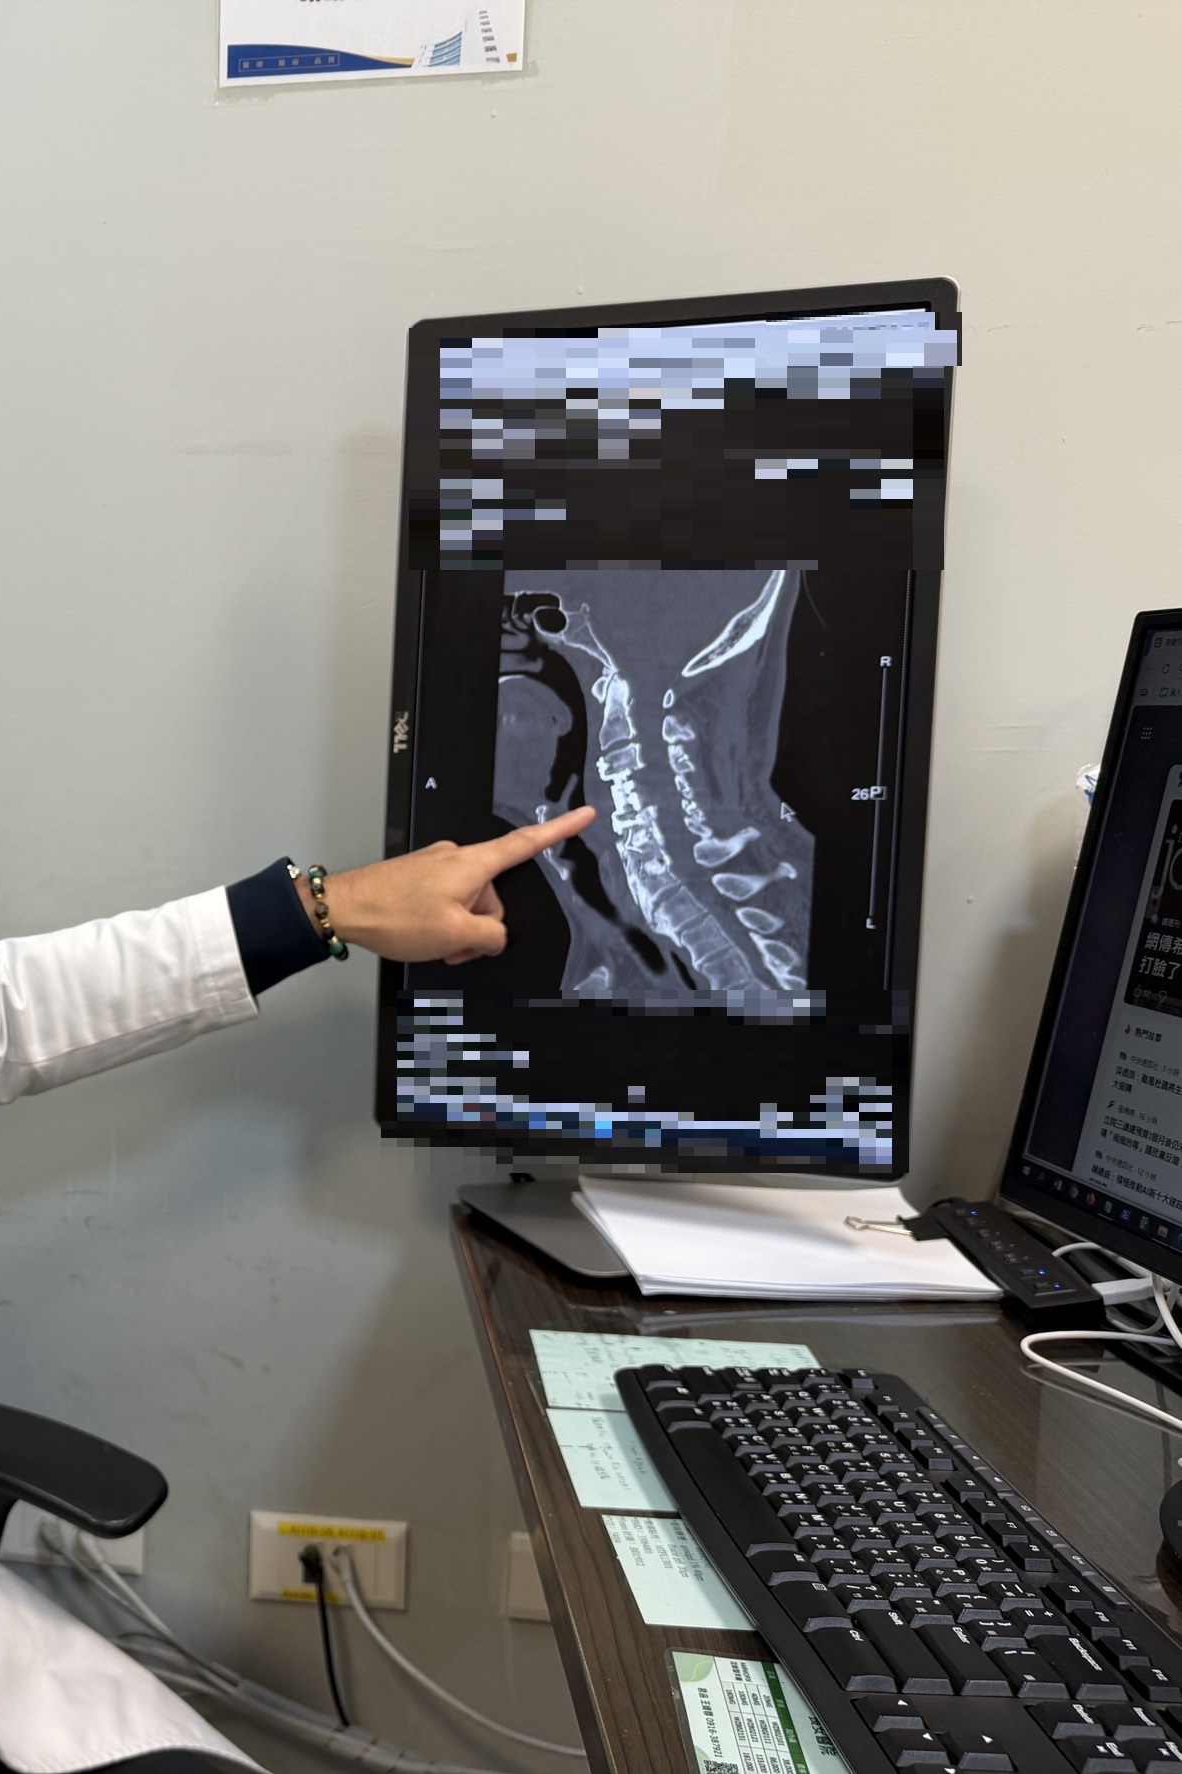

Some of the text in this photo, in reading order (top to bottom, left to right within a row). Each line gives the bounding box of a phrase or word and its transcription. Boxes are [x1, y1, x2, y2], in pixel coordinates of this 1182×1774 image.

[880, 656, 892, 666] R
[393, 711, 409, 754] DELL
[425, 777, 437, 789] A
[866, 917, 876, 929] L
[1139, 956, 1181, 979] 打臉了
[888, 1612, 904, 1625] Shift
[850, 1630, 864, 1641] Ctrl
[952, 1627, 970, 1644] Enter
[1068, 1638, 1102, 1671] Backspace
[1072, 1704, 1094, 1724] Delete
[706, 1717, 723, 1758] 0916-387921
[1105, 1742, 1125, 1757] End
